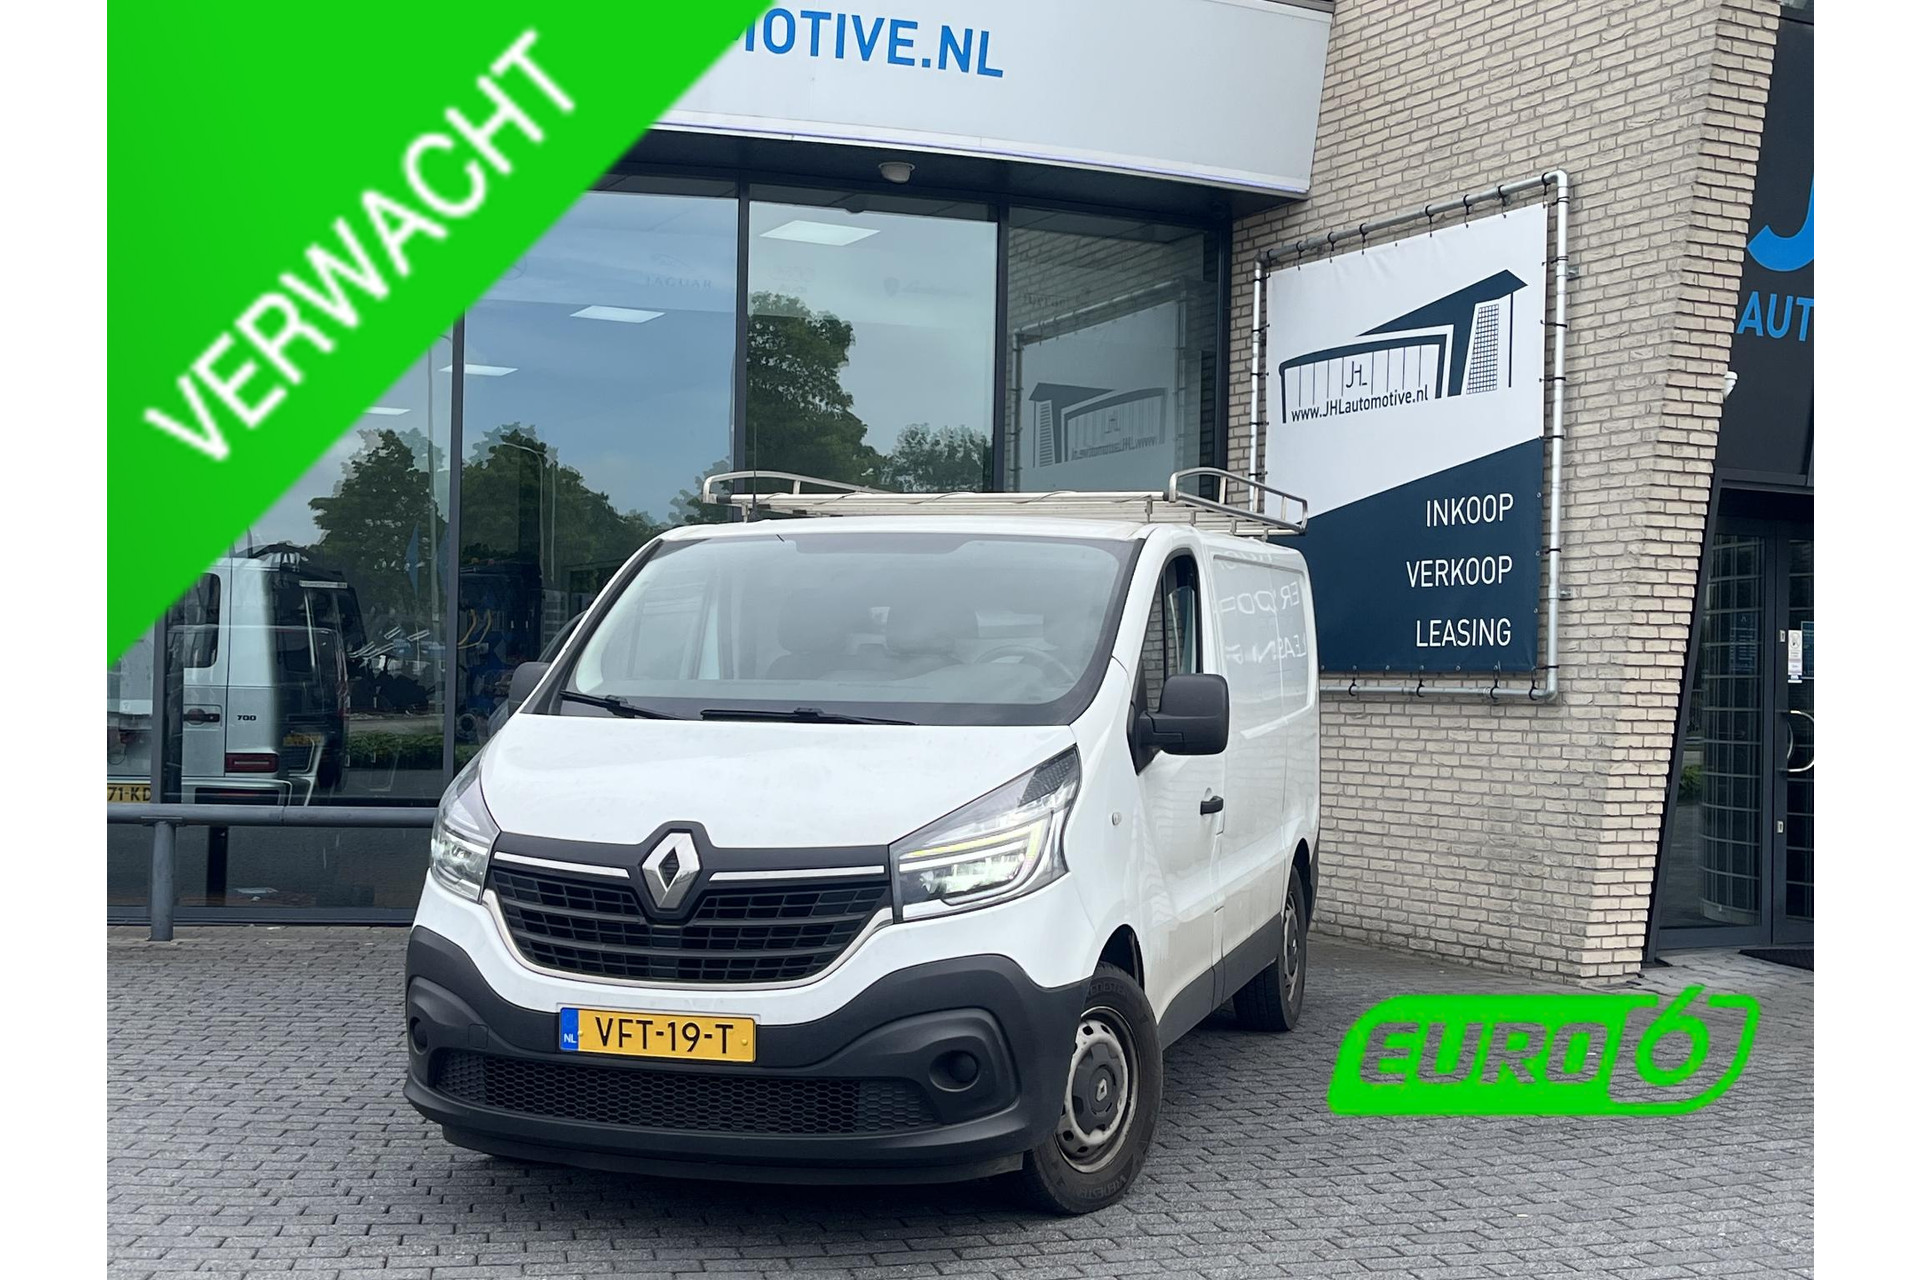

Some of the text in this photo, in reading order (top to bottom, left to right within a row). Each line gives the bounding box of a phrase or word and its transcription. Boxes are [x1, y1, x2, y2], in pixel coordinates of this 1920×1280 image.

[1291, 384, 1428, 422] www.JHLautomotive.nl
[1426, 493, 1514, 527] INKOOP
[1406, 555, 1513, 588] VERKOOP
[1416, 618, 1511, 647] LEASING
[563, 1033, 577, 1043] NL
[595, 1016, 734, 1054] VFT-19-T
